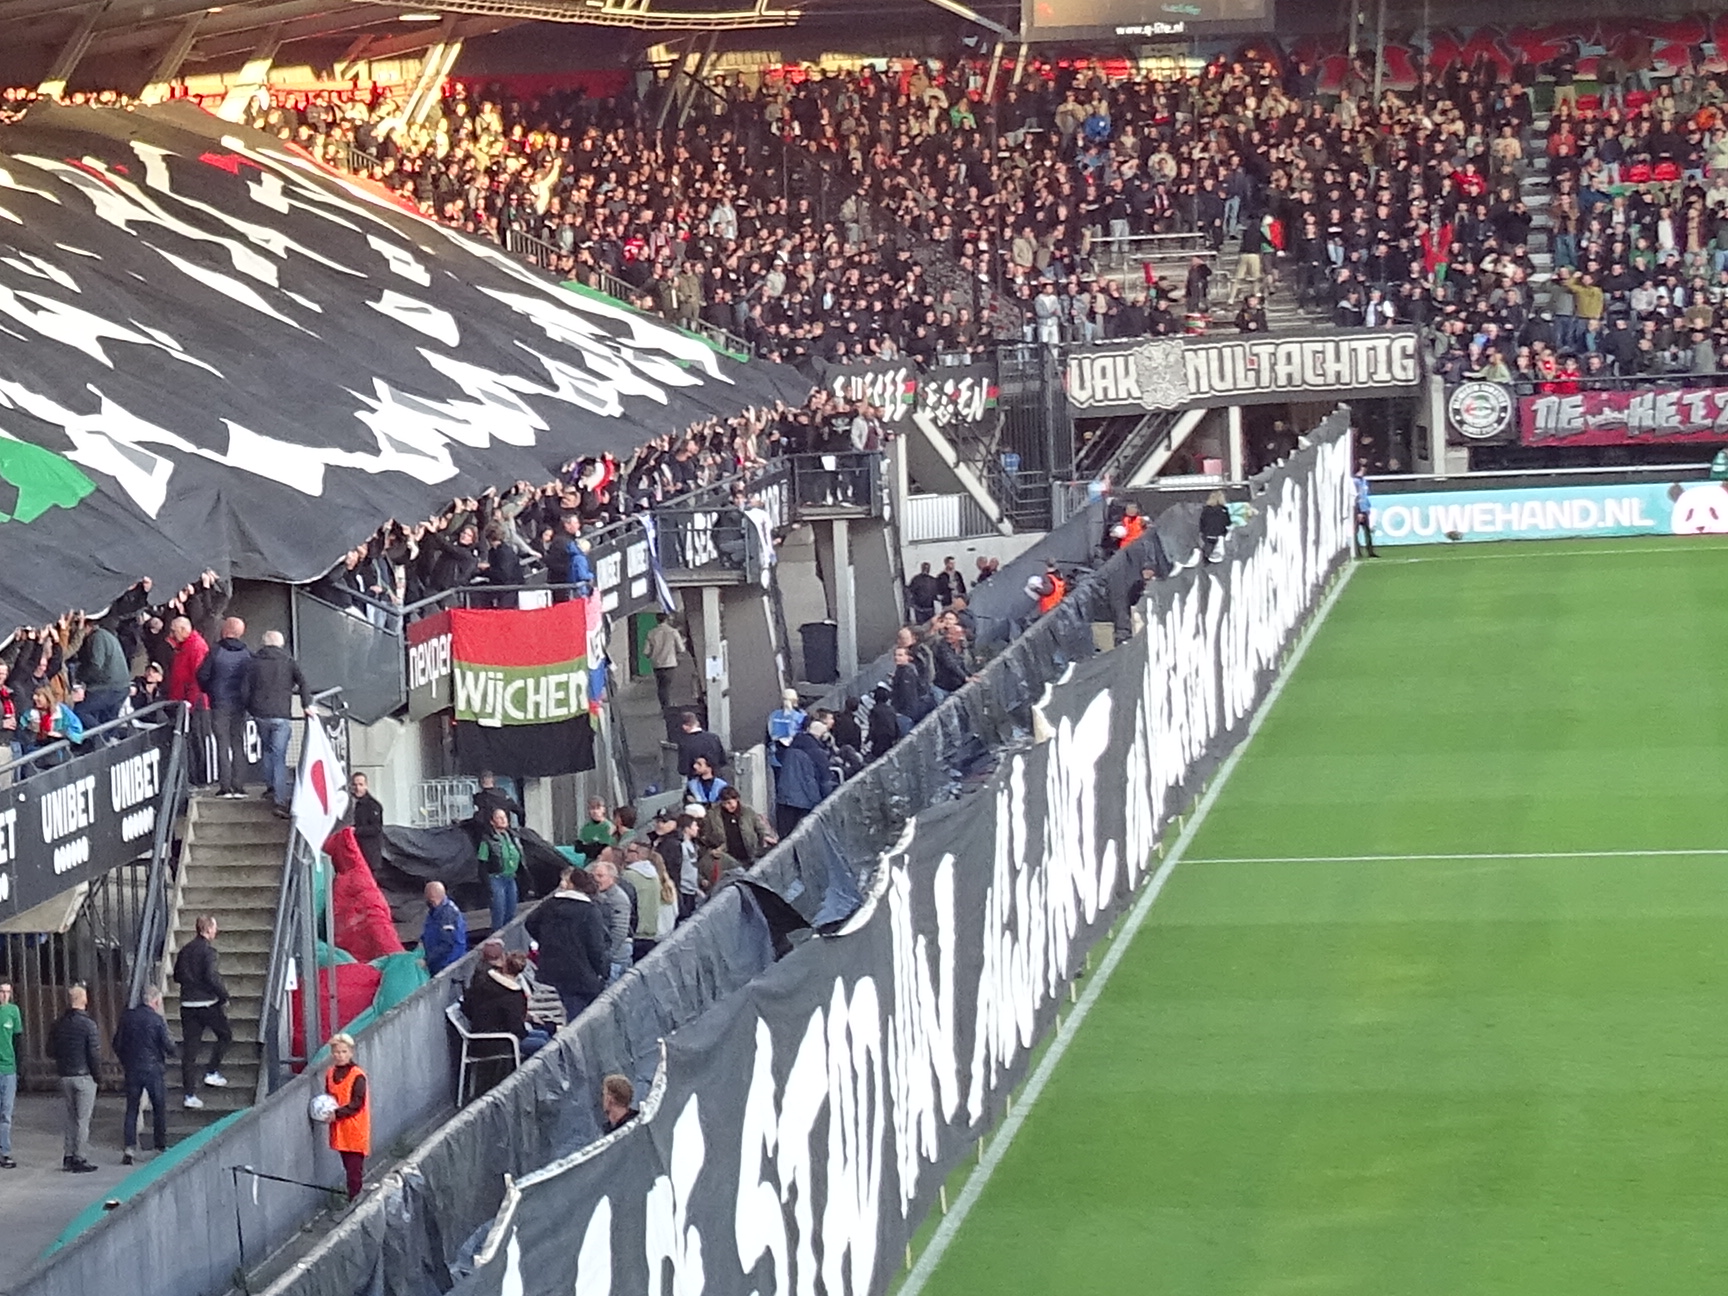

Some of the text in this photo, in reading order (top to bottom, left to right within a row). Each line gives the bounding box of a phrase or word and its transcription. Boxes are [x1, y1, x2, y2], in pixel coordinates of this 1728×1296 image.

[1530, 393, 1587, 442] DE
[41, 774, 96, 844] UNIBET
[111, 747, 161, 813] UNIBET
